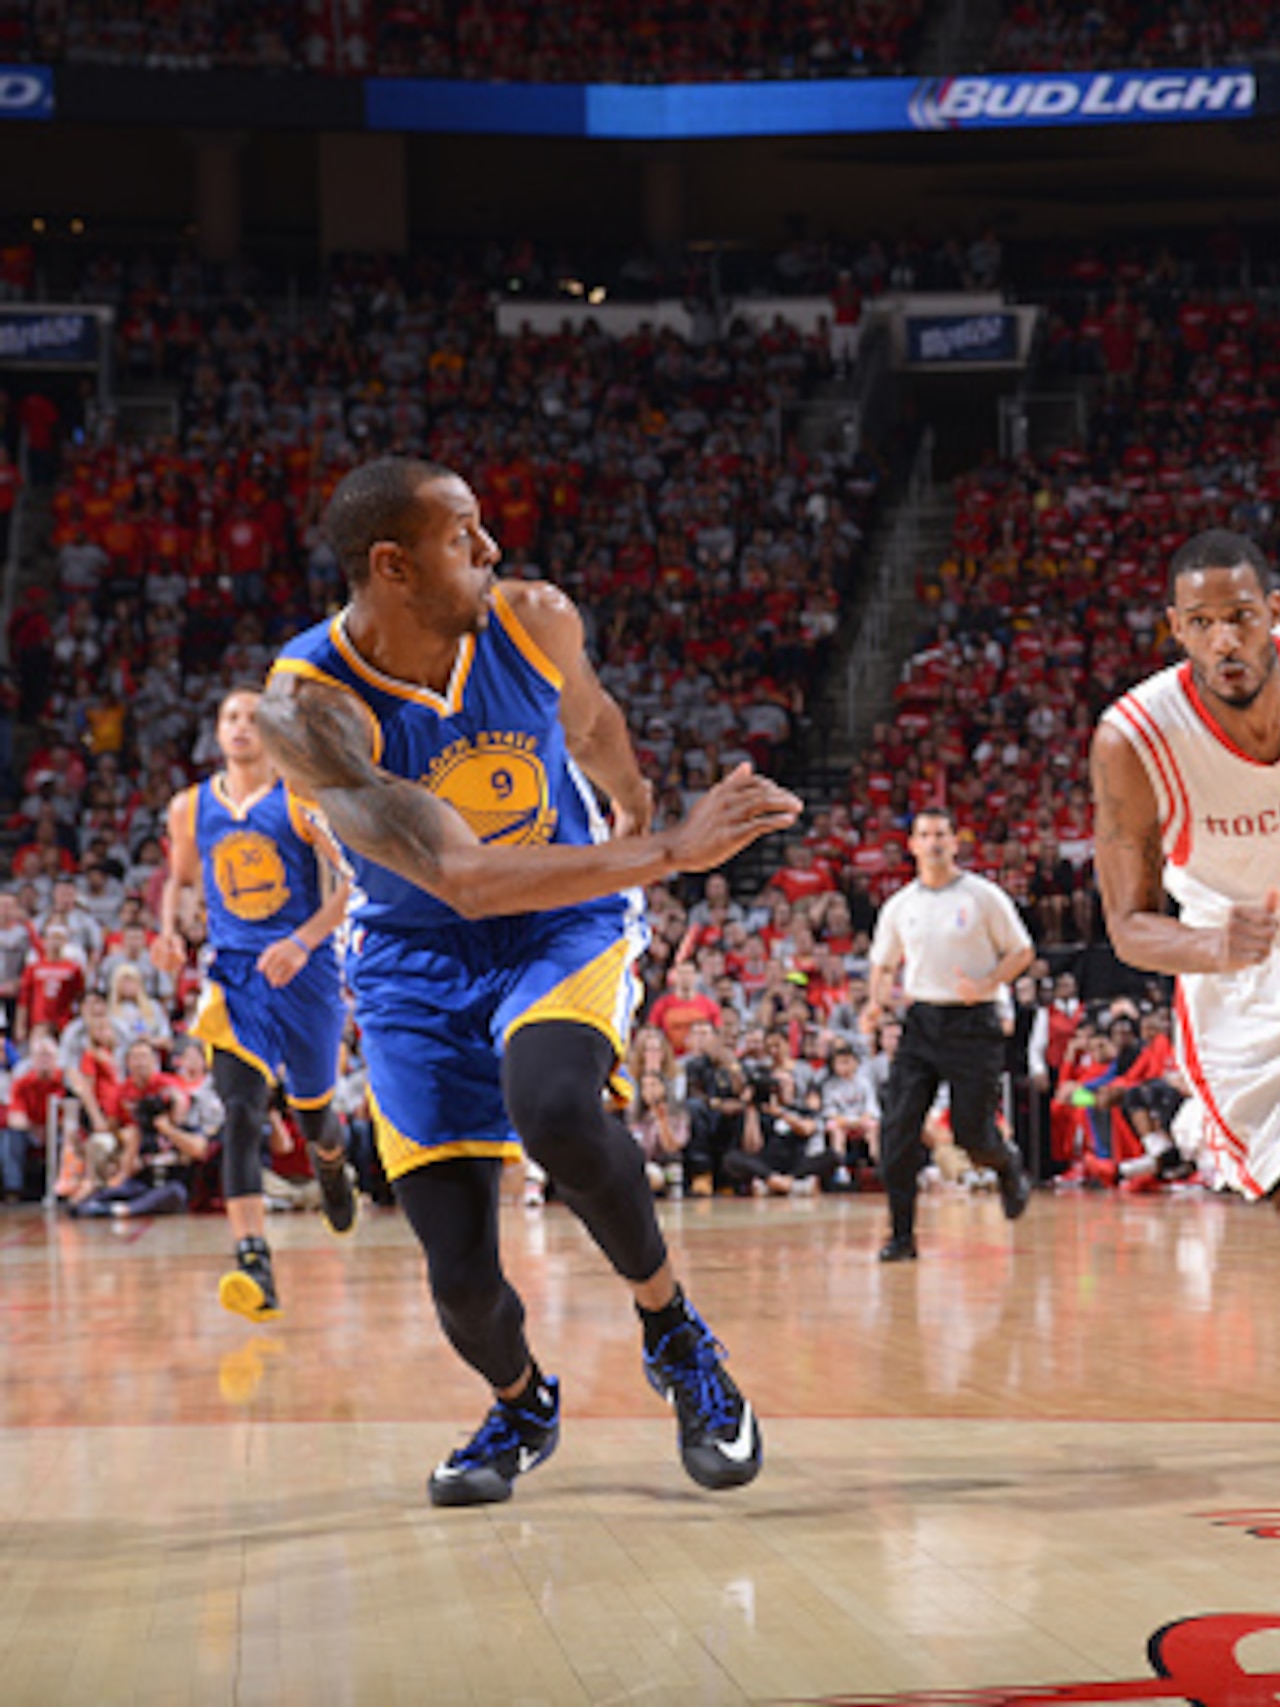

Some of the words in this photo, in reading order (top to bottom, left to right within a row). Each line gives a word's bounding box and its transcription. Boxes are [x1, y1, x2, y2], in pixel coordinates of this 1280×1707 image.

[939, 80, 1080, 118] BUD
[1081, 74, 1255, 114] LIGHT
[491, 768, 514, 800] 9
